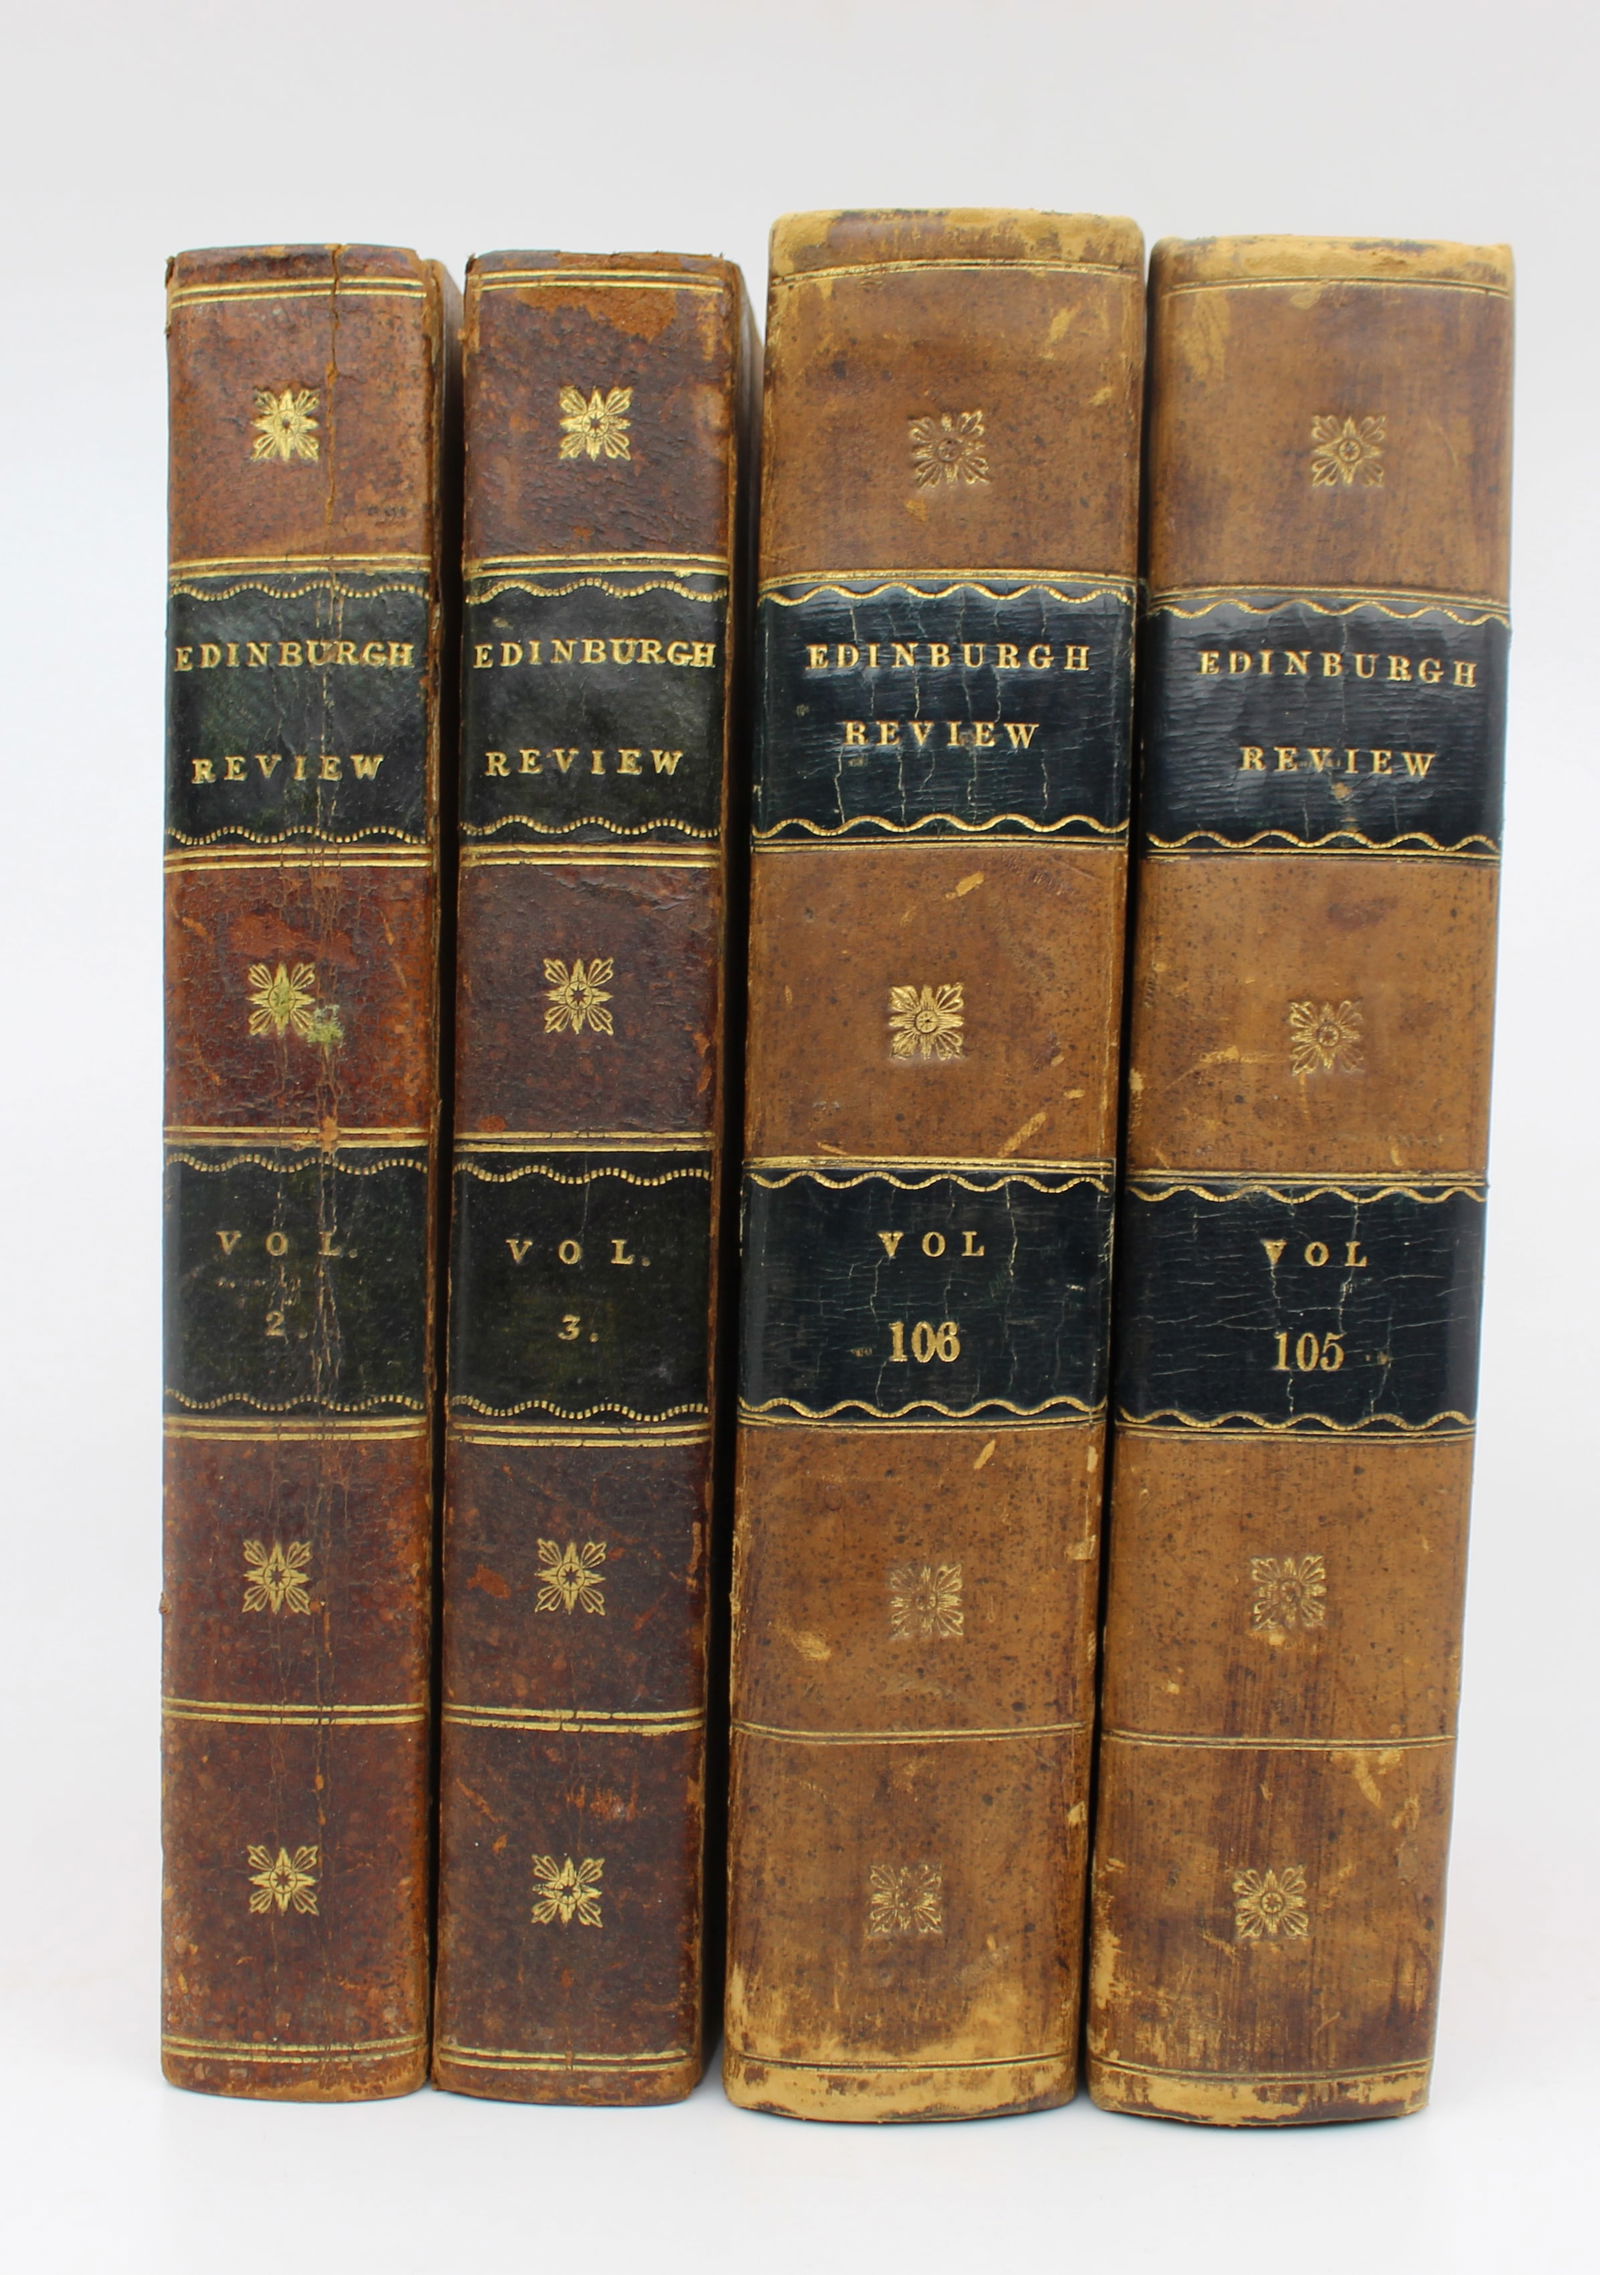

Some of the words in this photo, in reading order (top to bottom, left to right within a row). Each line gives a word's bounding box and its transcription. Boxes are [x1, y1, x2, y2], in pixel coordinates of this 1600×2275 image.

[174, 640, 416, 672] EDINBURGH
[473, 637, 717, 669] EDINBURGH
[806, 642, 1092, 672] EDINBURGH
[1198, 650, 1478, 688] EDINBURGH
[843, 720, 1040, 751] REVIEW
[191, 753, 384, 785] REVIEW
[485, 748, 685, 777] REVIEW
[1239, 745, 1436, 778] REVIEW
[505, 1238, 652, 1267] VOL.
[878, 1230, 985, 1259] VOL
[1264, 1238, 1367, 1268] VOL
[557, 1314, 600, 1343] 3.
[887, 1321, 961, 1363] 106
[1274, 1331, 1345, 1372] 105
